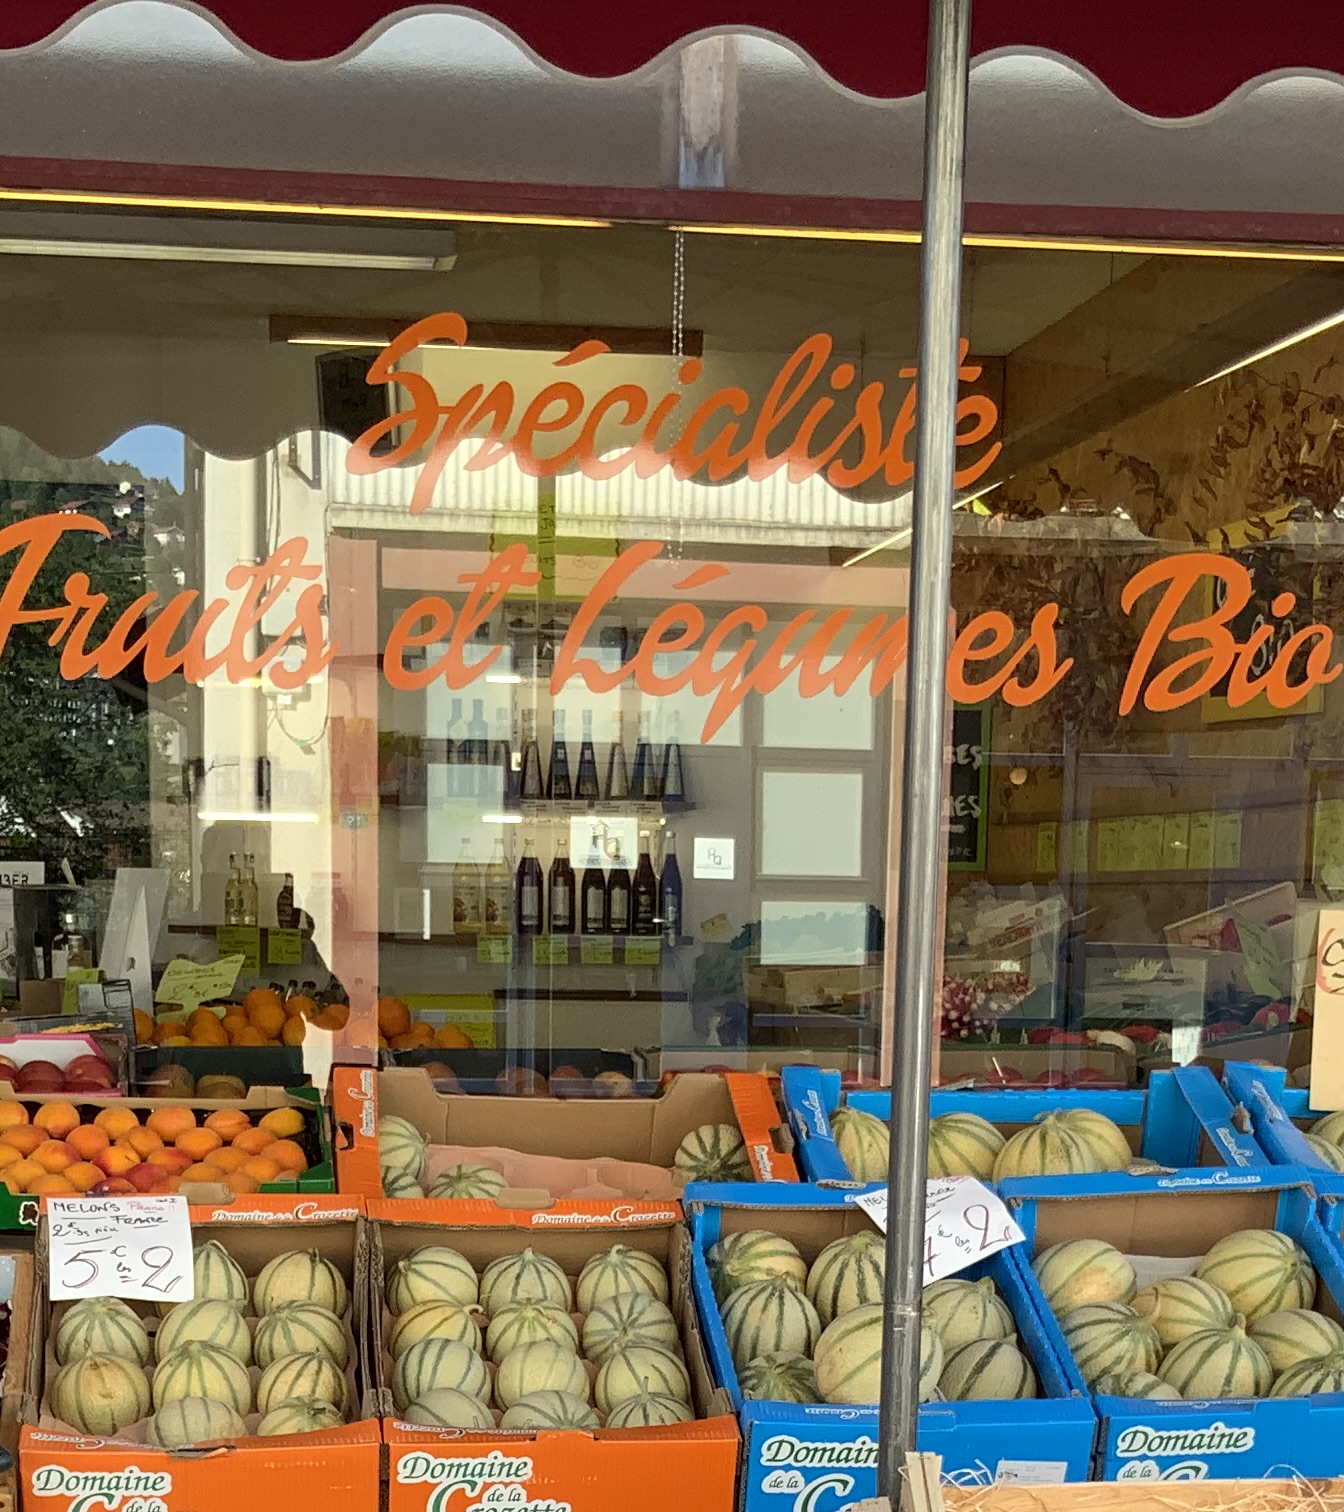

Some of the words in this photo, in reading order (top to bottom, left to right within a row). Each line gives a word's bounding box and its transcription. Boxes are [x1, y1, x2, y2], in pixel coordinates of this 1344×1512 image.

[381, 541, 544, 692] et
[556, 537, 1076, 746] Légumes
[1117, 552, 1342, 720] Bio
[53, 1201, 121, 1213] MELONS
[963, 1204, 1013, 1251] 2
[62, 1249, 107, 1289] 5
[110, 1245, 127, 1258] €
[141, 1246, 185, 1293] 2
[766, 1436, 878, 1464] Domain
[1120, 1425, 1249, 1454] Domaine
[36, 1466, 165, 1497] Domaine
[402, 1453, 529, 1487] Domaine
[769, 1476, 784, 1489] de
[786, 1475, 799, 1489] la
[1123, 1465, 1137, 1479] de
[1140, 1465, 1152, 1479] la
[487, 1487, 507, 1504] de
[509, 1487, 523, 1502] la
